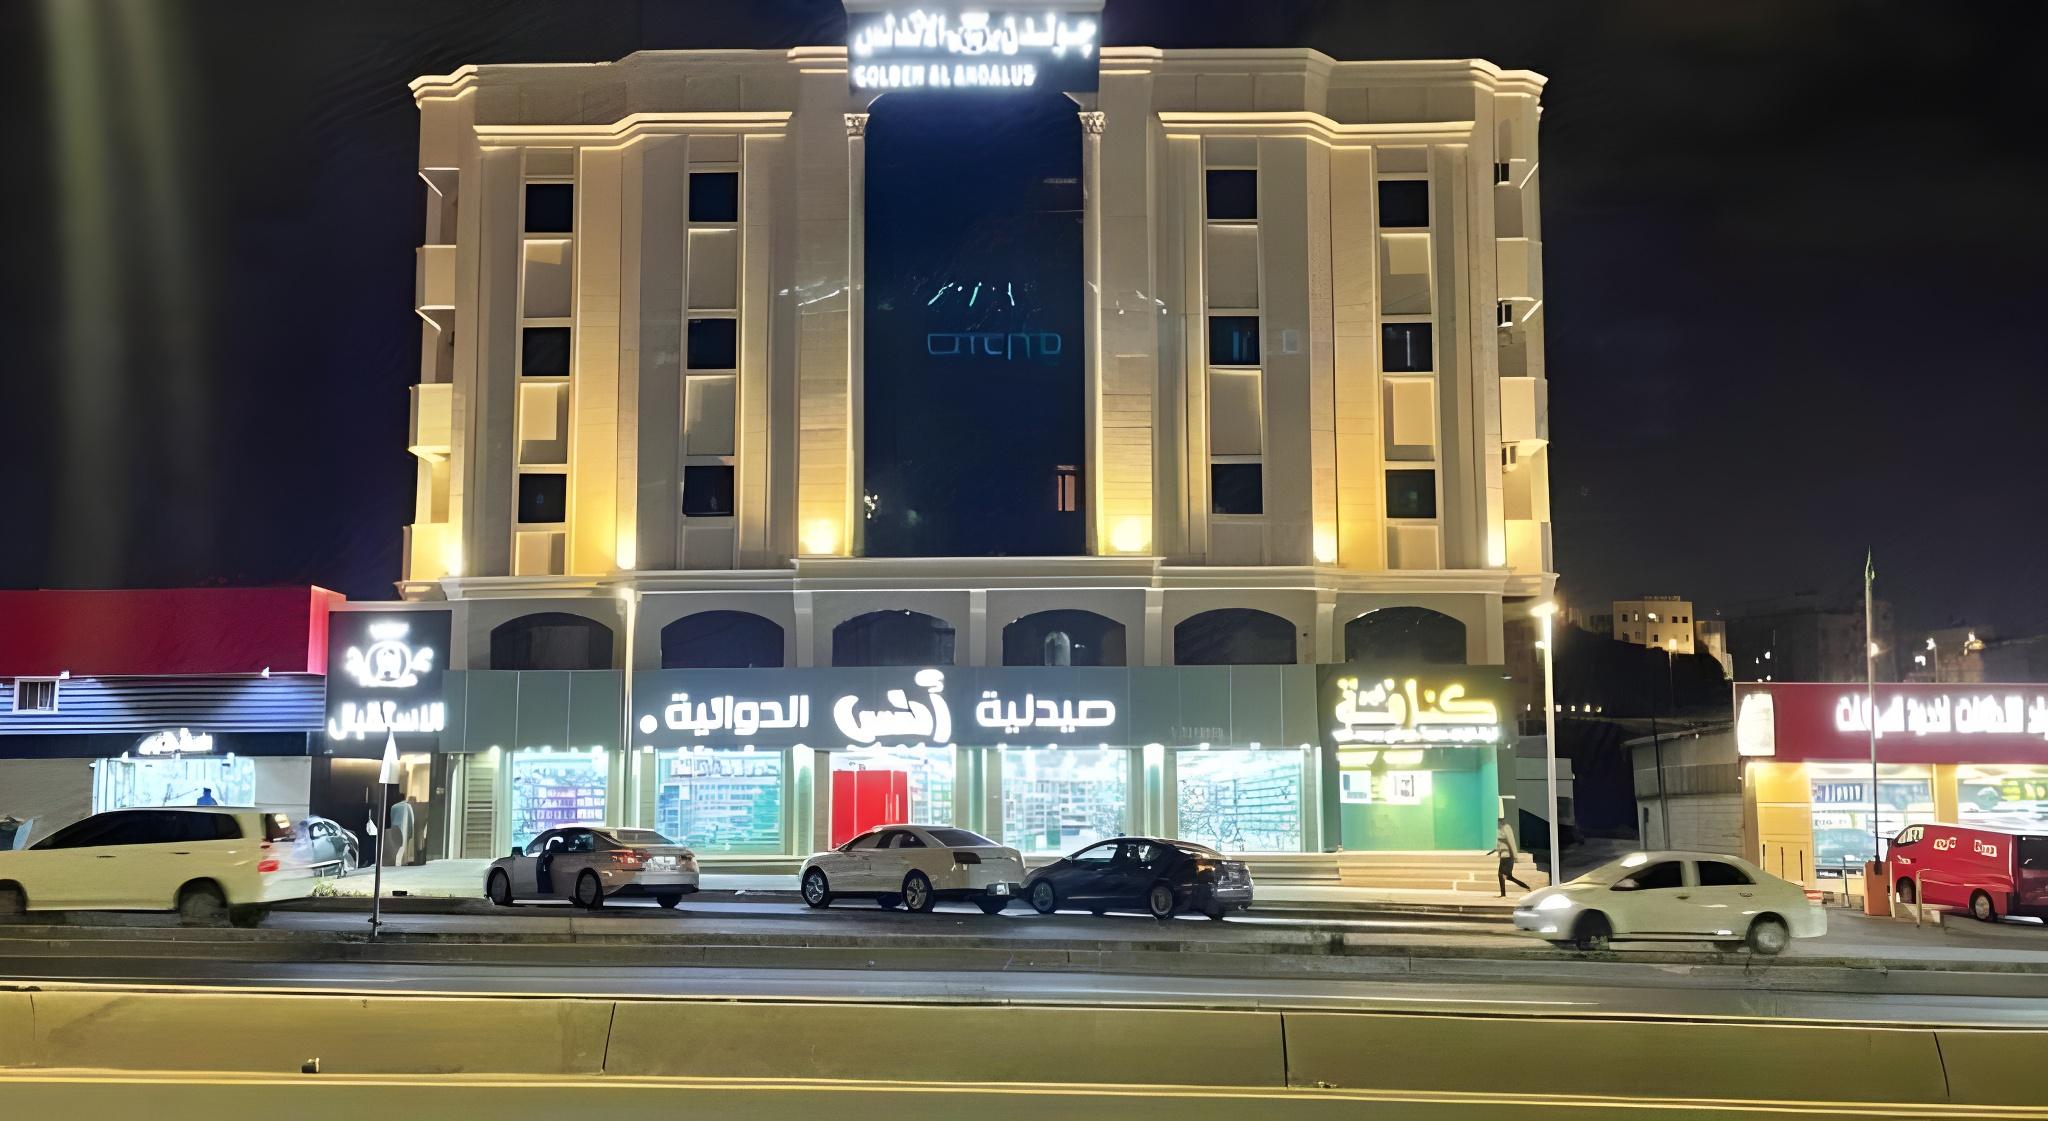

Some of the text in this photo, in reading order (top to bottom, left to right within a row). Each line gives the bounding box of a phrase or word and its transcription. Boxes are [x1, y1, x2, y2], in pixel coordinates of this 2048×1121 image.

[854, 64, 1036, 87] GOLDEN AL ANDALUS
[328, 701, 445, 741] الاستقبال
[975, 690, 1117, 734] صيدلية
